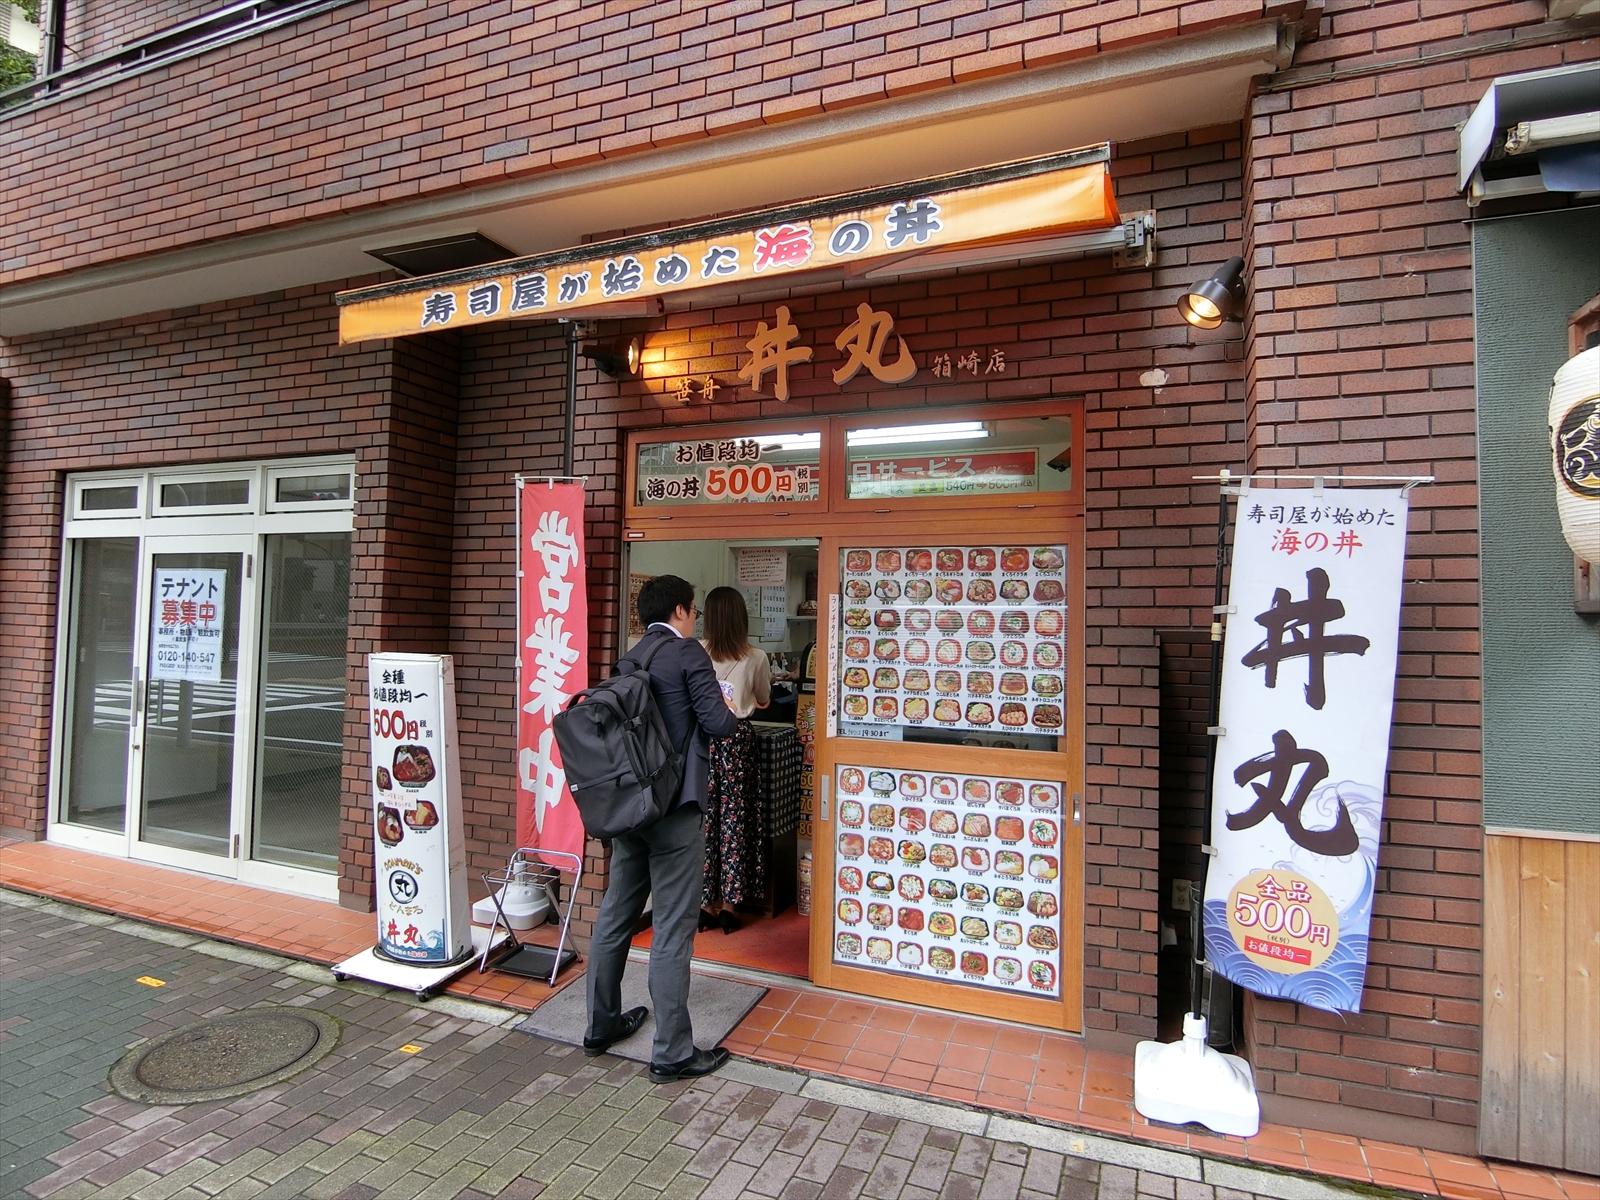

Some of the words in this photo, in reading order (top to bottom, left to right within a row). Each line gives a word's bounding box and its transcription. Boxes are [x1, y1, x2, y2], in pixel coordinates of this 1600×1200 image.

[738, 302, 917, 402] 丼丸
[931, 349, 1006, 379] 箱崎店
[675, 440, 783, 462] お値段均一
[647, 477, 700, 499] 海の丼
[706, 467, 793, 496] 500円
[1247, 504, 1395, 526] 寿司屋が始めた
[1271, 527, 1363, 559] 海の丼
[161, 578, 218, 599] テナント
[161, 599, 217, 628] 募集中
[382, 669, 405, 684] 全種
[520, 510, 580, 833] 営業中
[374, 686, 428, 703] お値段均一
[374, 708, 419, 740] 500円
[1226, 567, 1371, 857] 丼丸
[1256, 873, 1313, 904] 全品
[389, 901, 424, 916] どんまる
[1233, 892, 1331, 948] 500円
[1247, 939, 1308, 960] お値段均一
